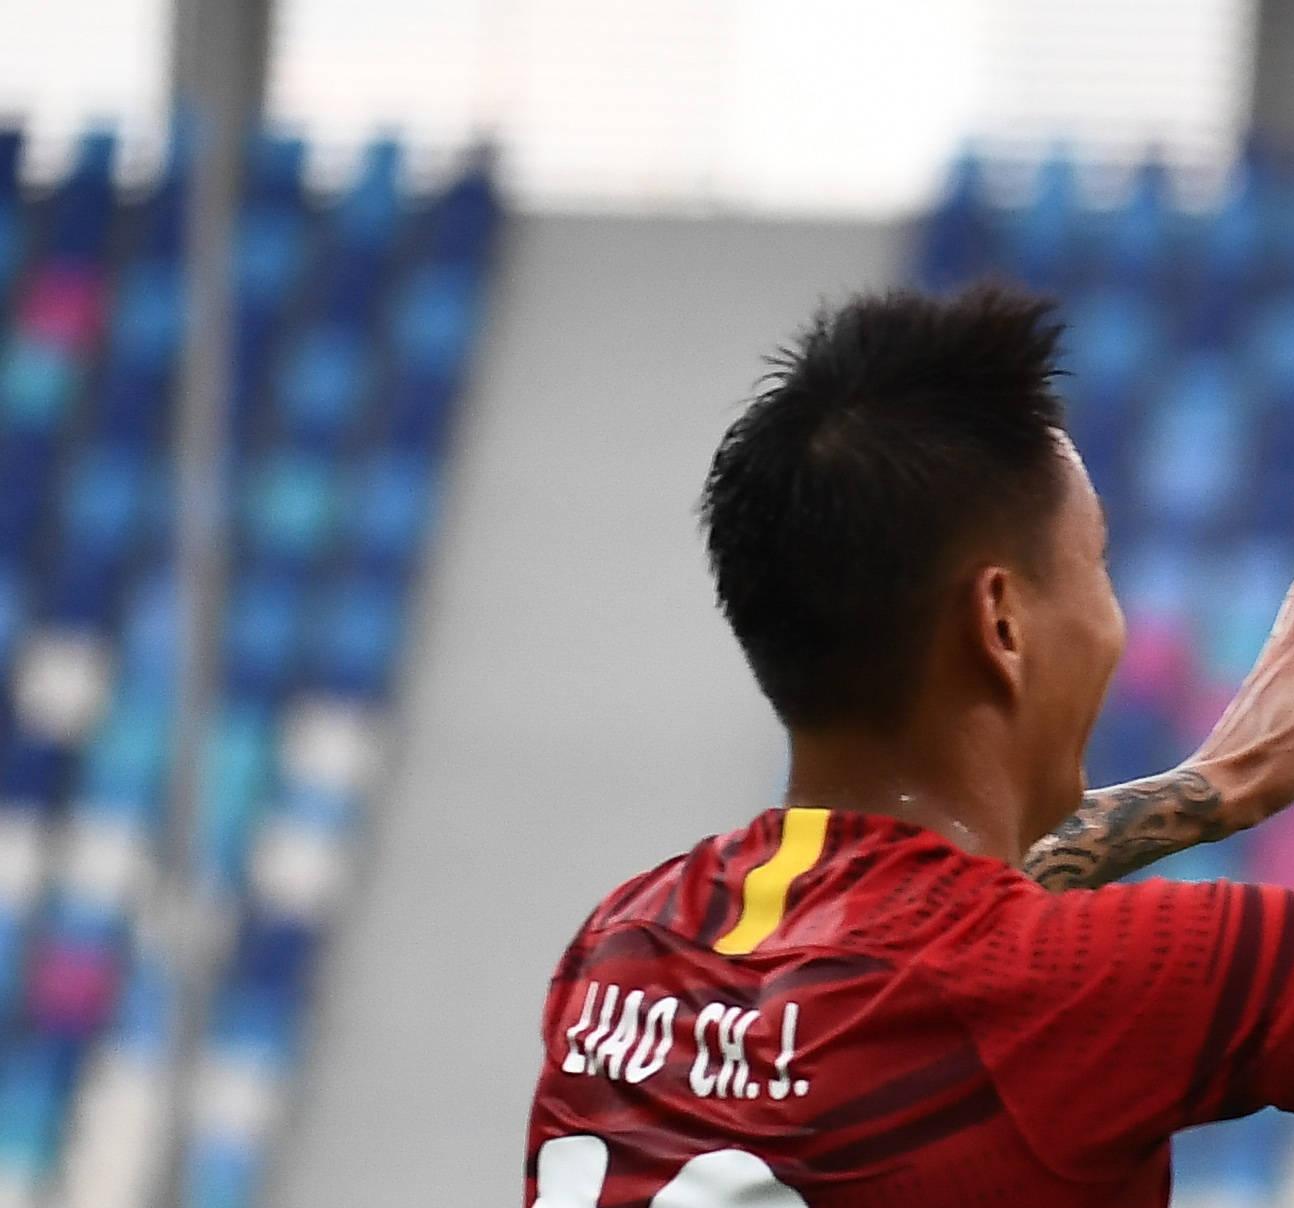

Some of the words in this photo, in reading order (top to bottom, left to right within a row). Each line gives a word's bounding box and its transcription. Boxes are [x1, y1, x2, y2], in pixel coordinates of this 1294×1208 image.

[562, 981, 678, 1083] LIAO
[689, 1003, 760, 1099] CH.
[768, 1002, 809, 1100] J.
